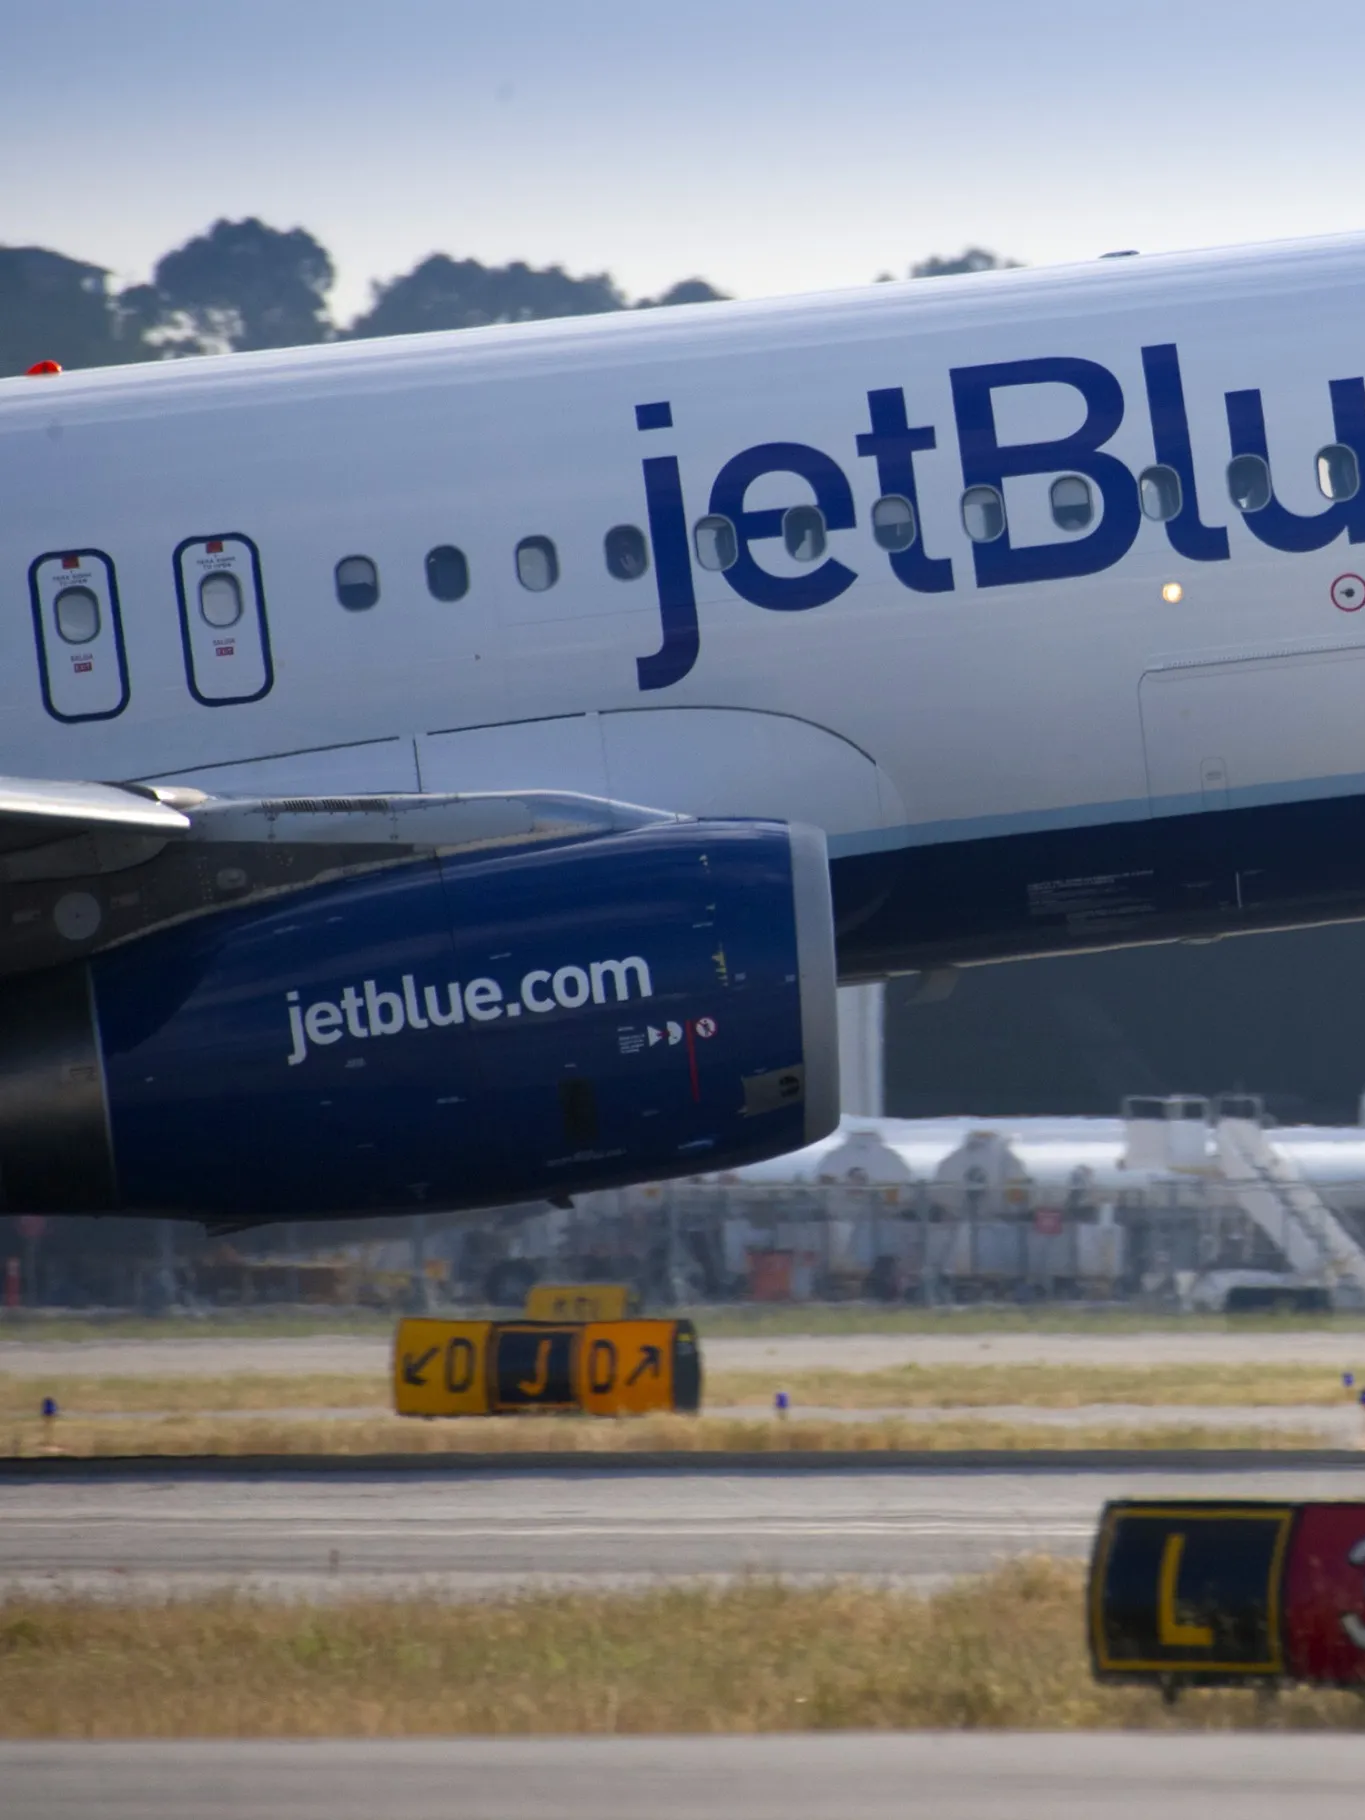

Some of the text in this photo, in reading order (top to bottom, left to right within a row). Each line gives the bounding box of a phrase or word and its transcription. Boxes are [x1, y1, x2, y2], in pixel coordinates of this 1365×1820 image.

[287, 956, 653, 1066] jetblue.com
[518, 1339, 552, 1396] J
[1158, 1532, 1214, 1646] L
